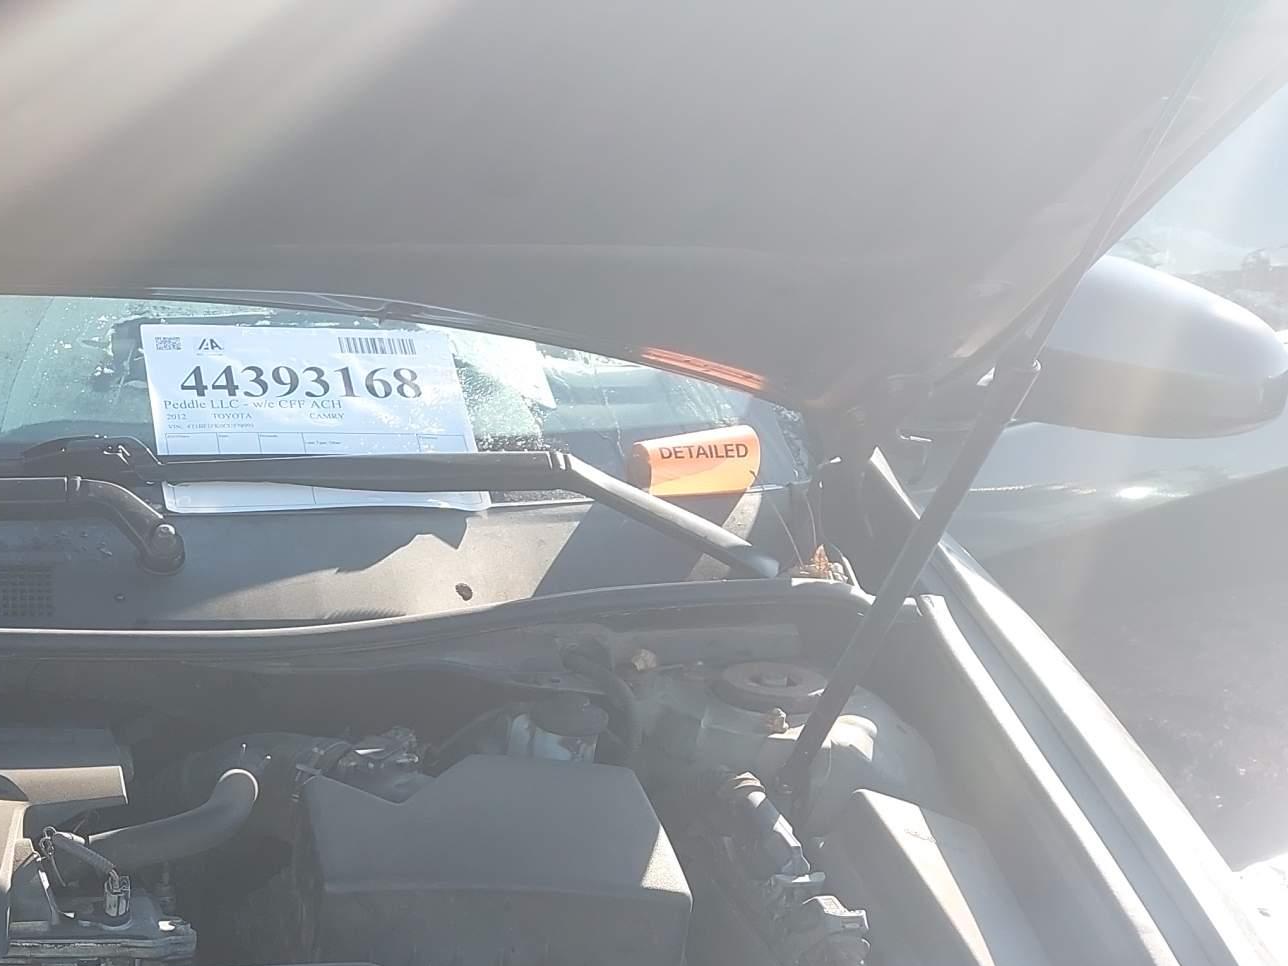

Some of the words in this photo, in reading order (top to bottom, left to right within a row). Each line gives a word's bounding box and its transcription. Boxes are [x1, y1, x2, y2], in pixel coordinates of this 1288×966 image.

[180, 365, 423, 399] 44393168
[164, 400, 206, 409] Peddle
[211, 400, 241, 409] LLC
[310, 399, 342, 409] ACH
[309, 412, 344, 420] CAMRY
[659, 443, 749, 459] DETAILED
